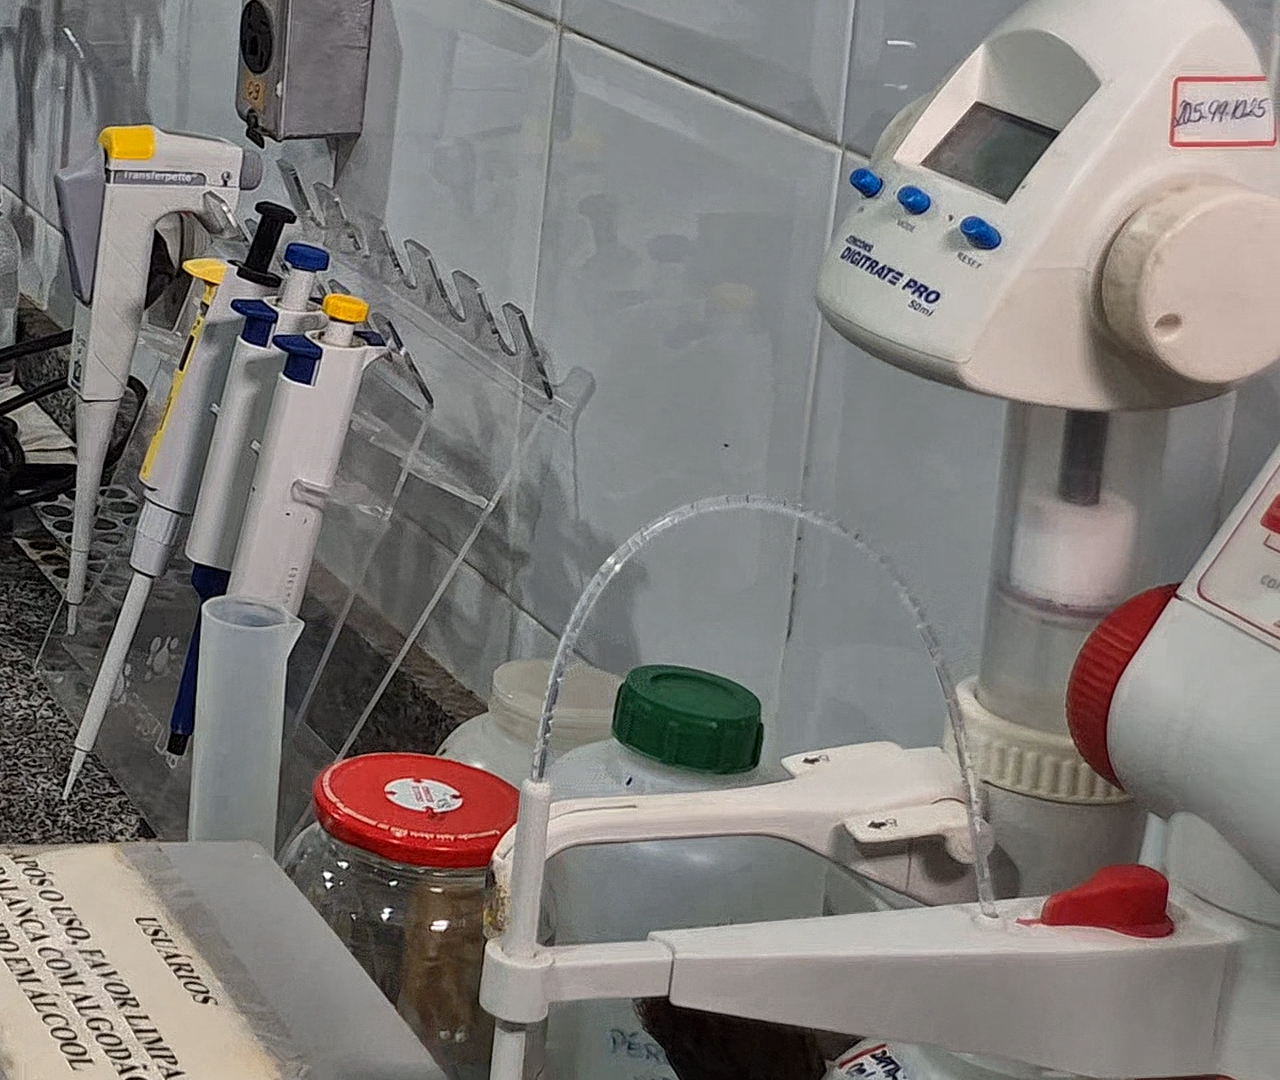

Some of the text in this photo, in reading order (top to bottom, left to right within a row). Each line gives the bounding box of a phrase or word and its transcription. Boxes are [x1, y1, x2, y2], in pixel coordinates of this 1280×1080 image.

[840, 246, 941, 304] DIGITRATE PRO
[7, 853, 54, 886] APÓS
[38, 889, 64, 902] O
[78, 949, 141, 1009] FAVOR
[134, 917, 219, 1006] USUÁRIOS
[3, 957, 43, 985] EM
[23, 988, 94, 1071] ÁLCOOL
[37, 947, 85, 987] COM
[66, 992, 149, 1080] ALGODÃ
